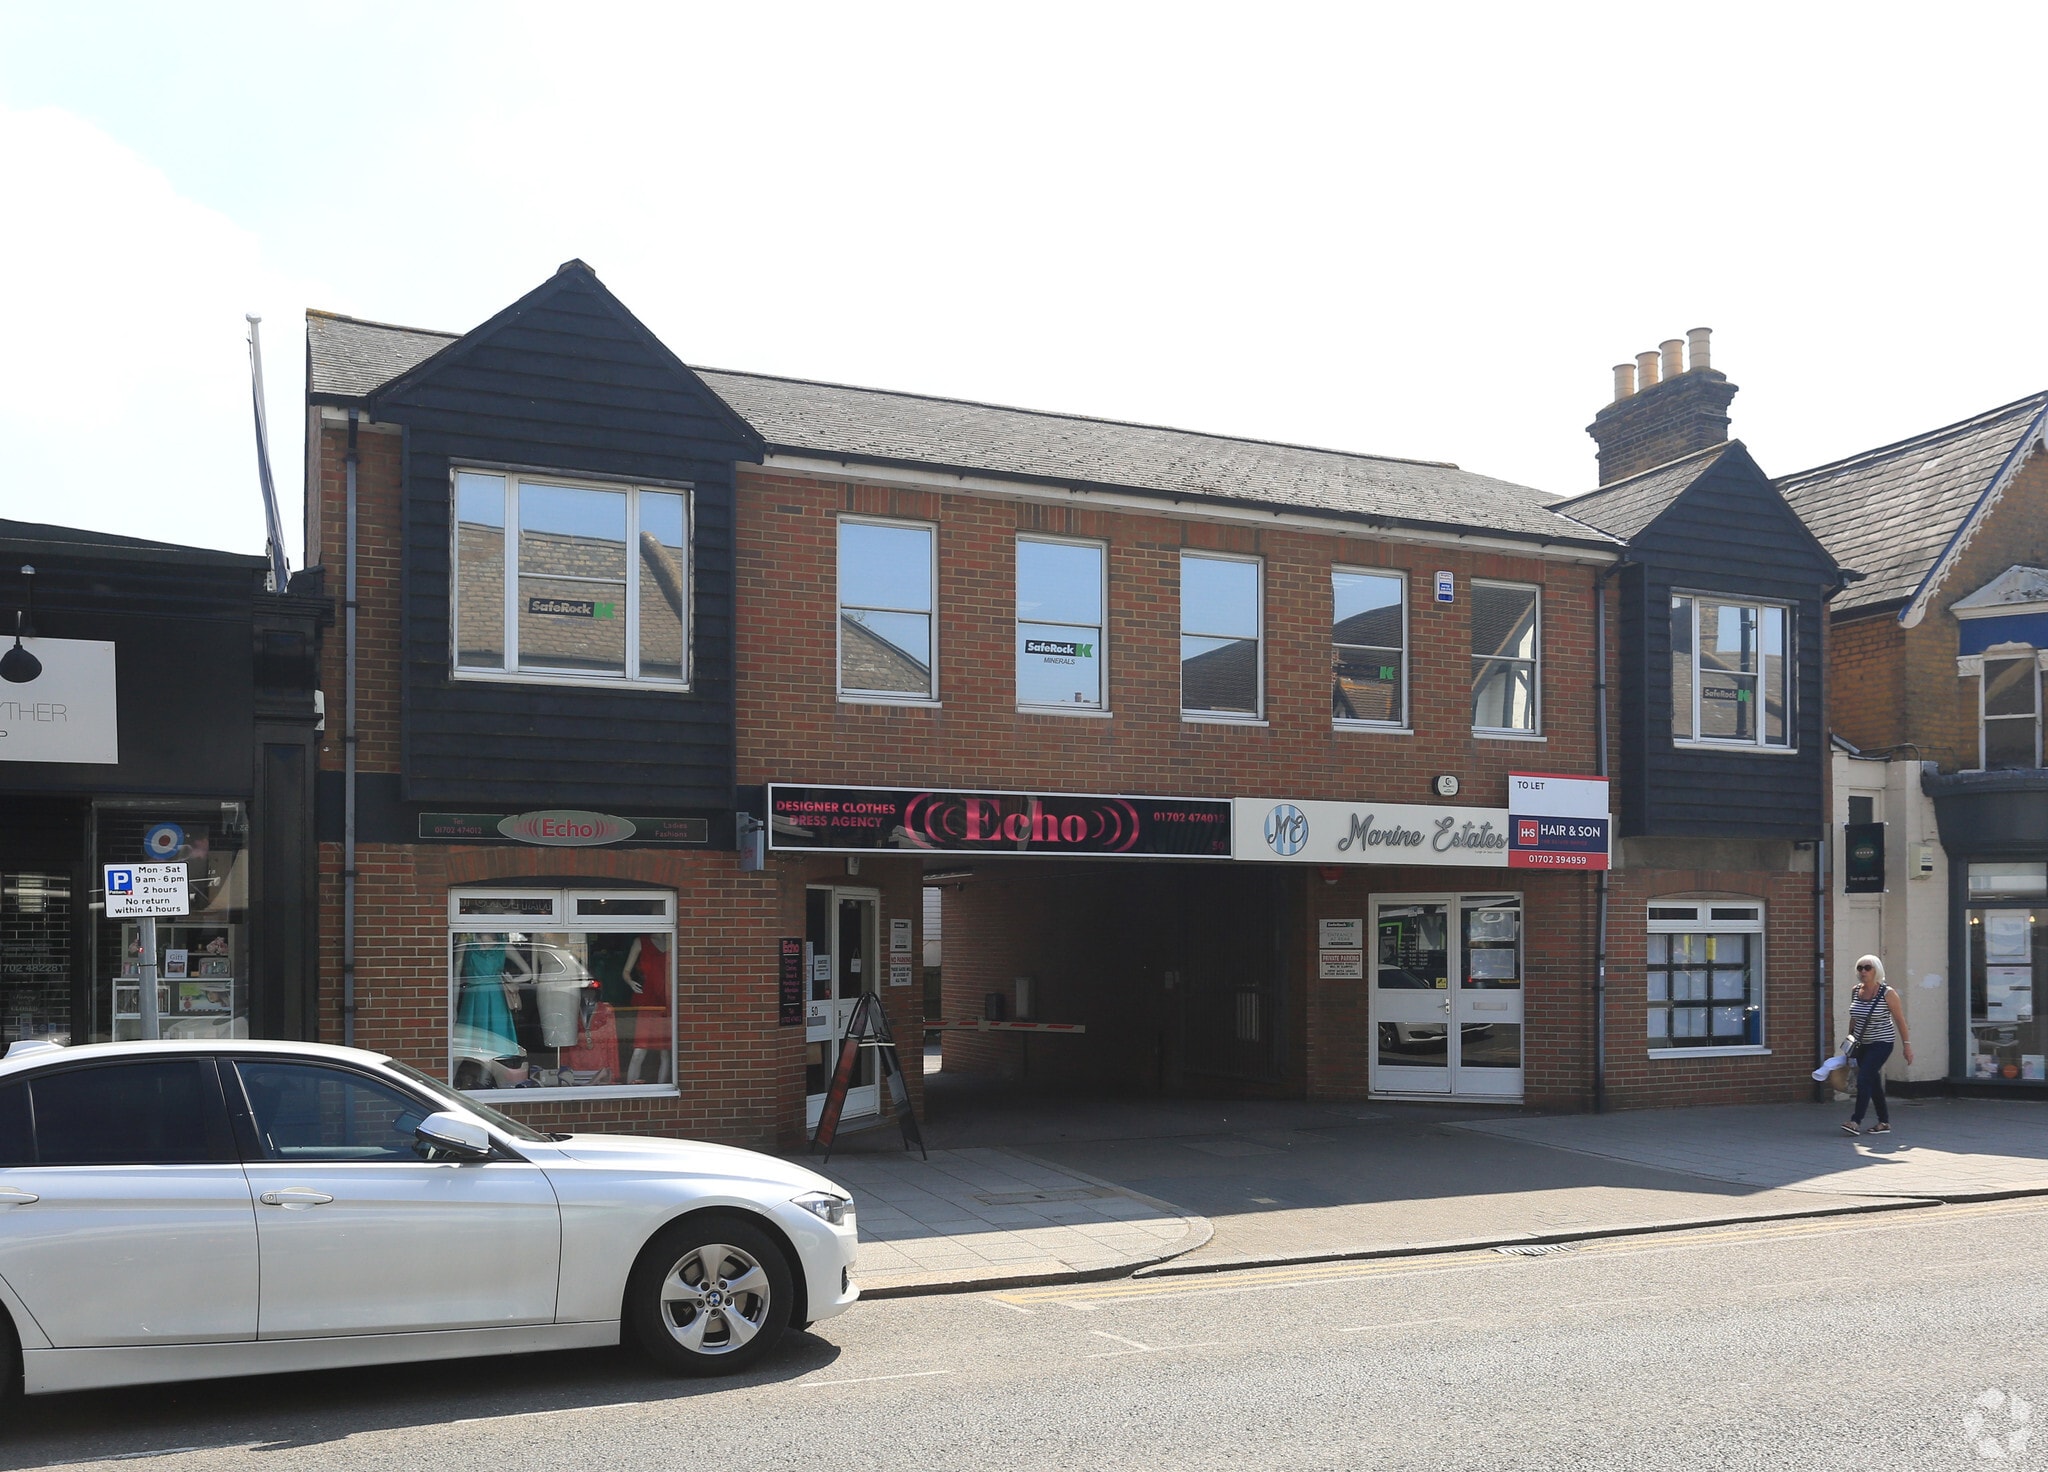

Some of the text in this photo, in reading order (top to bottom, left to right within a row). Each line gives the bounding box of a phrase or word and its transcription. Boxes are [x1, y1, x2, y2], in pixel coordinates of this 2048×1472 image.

[532, 600, 591, 614] SafeRock
[1027, 642, 1075, 654] SafeRock
[1044, 657, 1075, 665] MINERALS
[0, 701, 67, 722] THER
[1517, 781, 1545, 790] TO LET
[776, 800, 896, 815] DESIGNER CLOTHES
[789, 815, 883, 828] DRESS AGENCY
[961, 798, 1088, 844] Echo
[1153, 811, 1226, 824] 01702 474012
[435, 826, 482, 835] 01702 474012
[542, 818, 594, 838] Echo
[663, 821, 688, 829] Ladies
[1540, 824, 1601, 837] HAIR & SON
[655, 830, 688, 838] Fashions
[1337, 812, 1509, 853] Marine Estates
[1528, 855, 1587, 865] 01702 394959
[115, 906, 143, 914] within
[25, 963, 63, 972] 482281
[811, 1006, 819, 1016] 50
